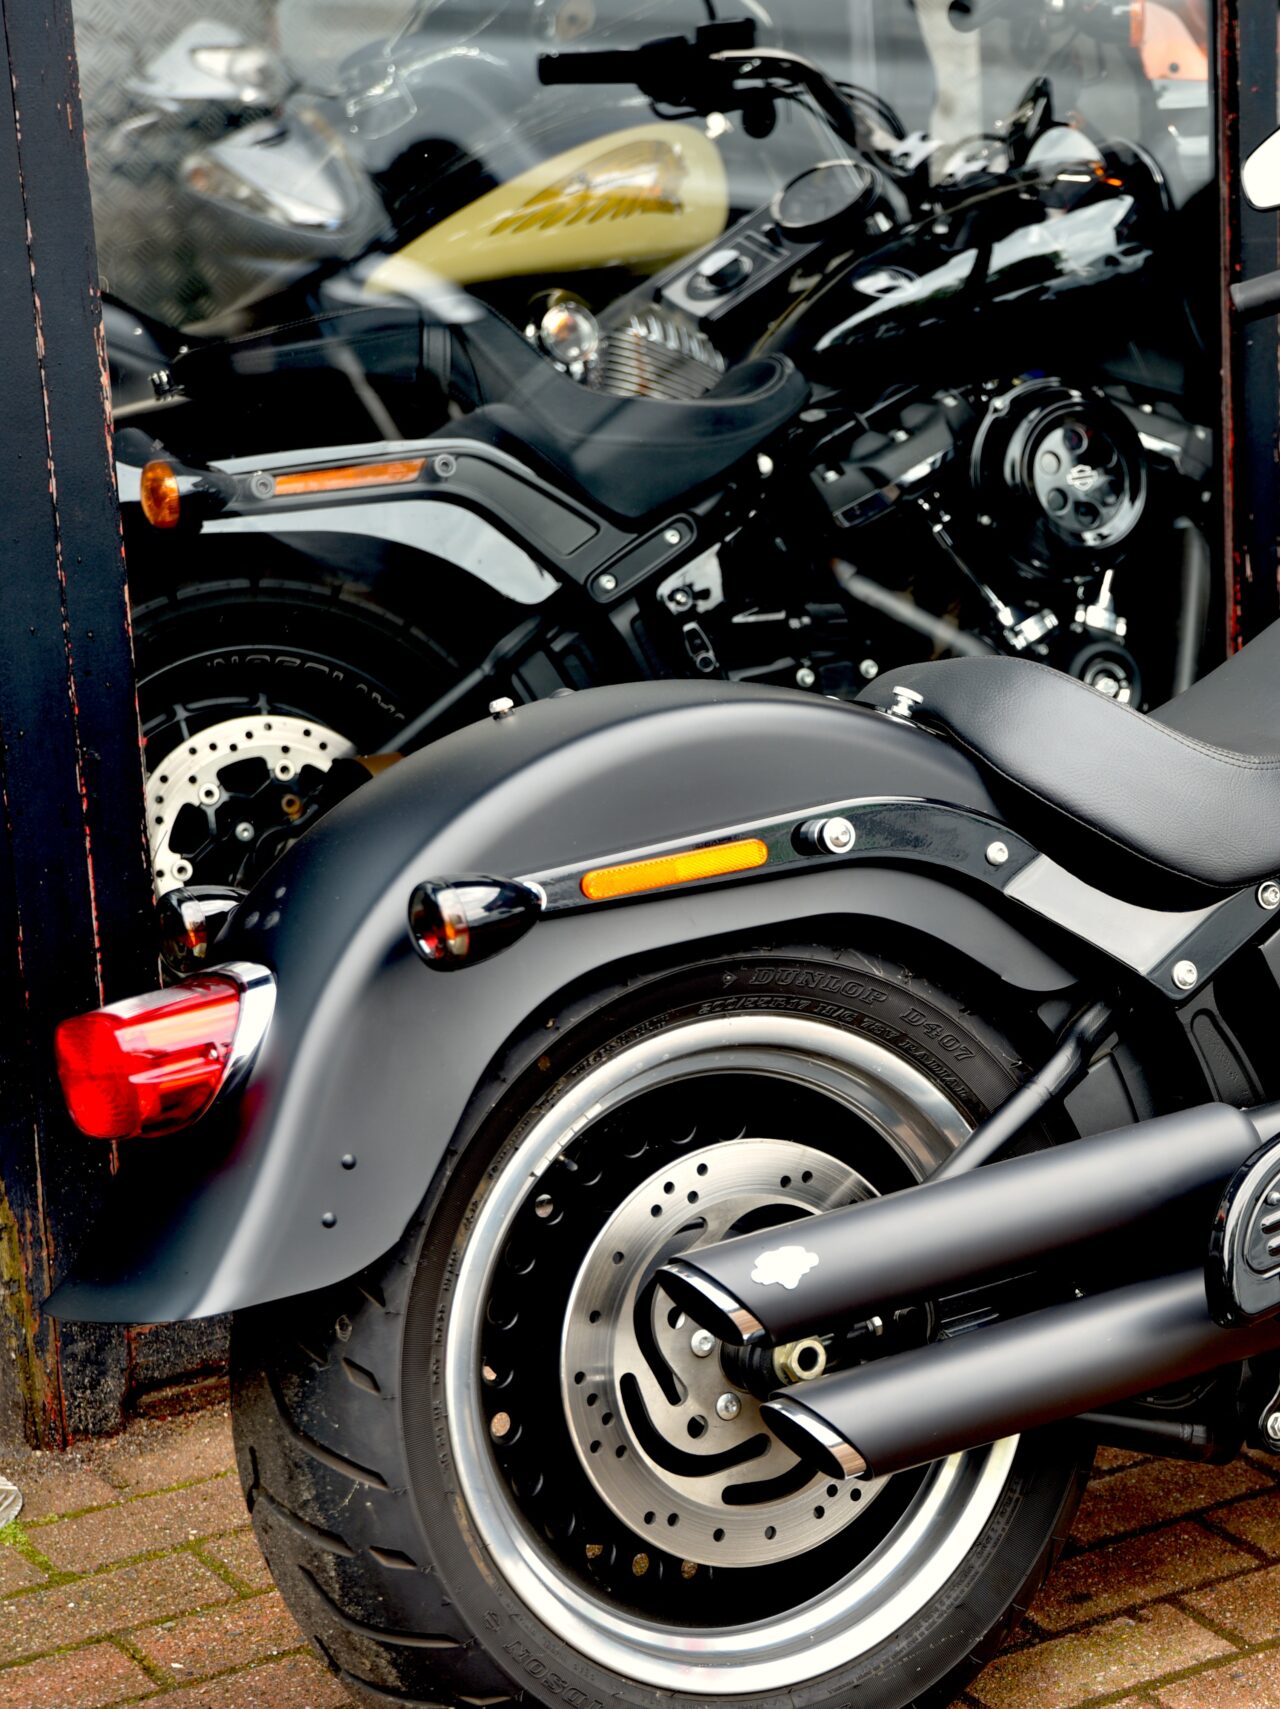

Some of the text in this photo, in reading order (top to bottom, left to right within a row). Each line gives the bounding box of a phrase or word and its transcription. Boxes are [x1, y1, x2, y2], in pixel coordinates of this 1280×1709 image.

[750, 967, 976, 1061] DUNLOP D407
[898, 1038, 970, 1099] RADIAL
